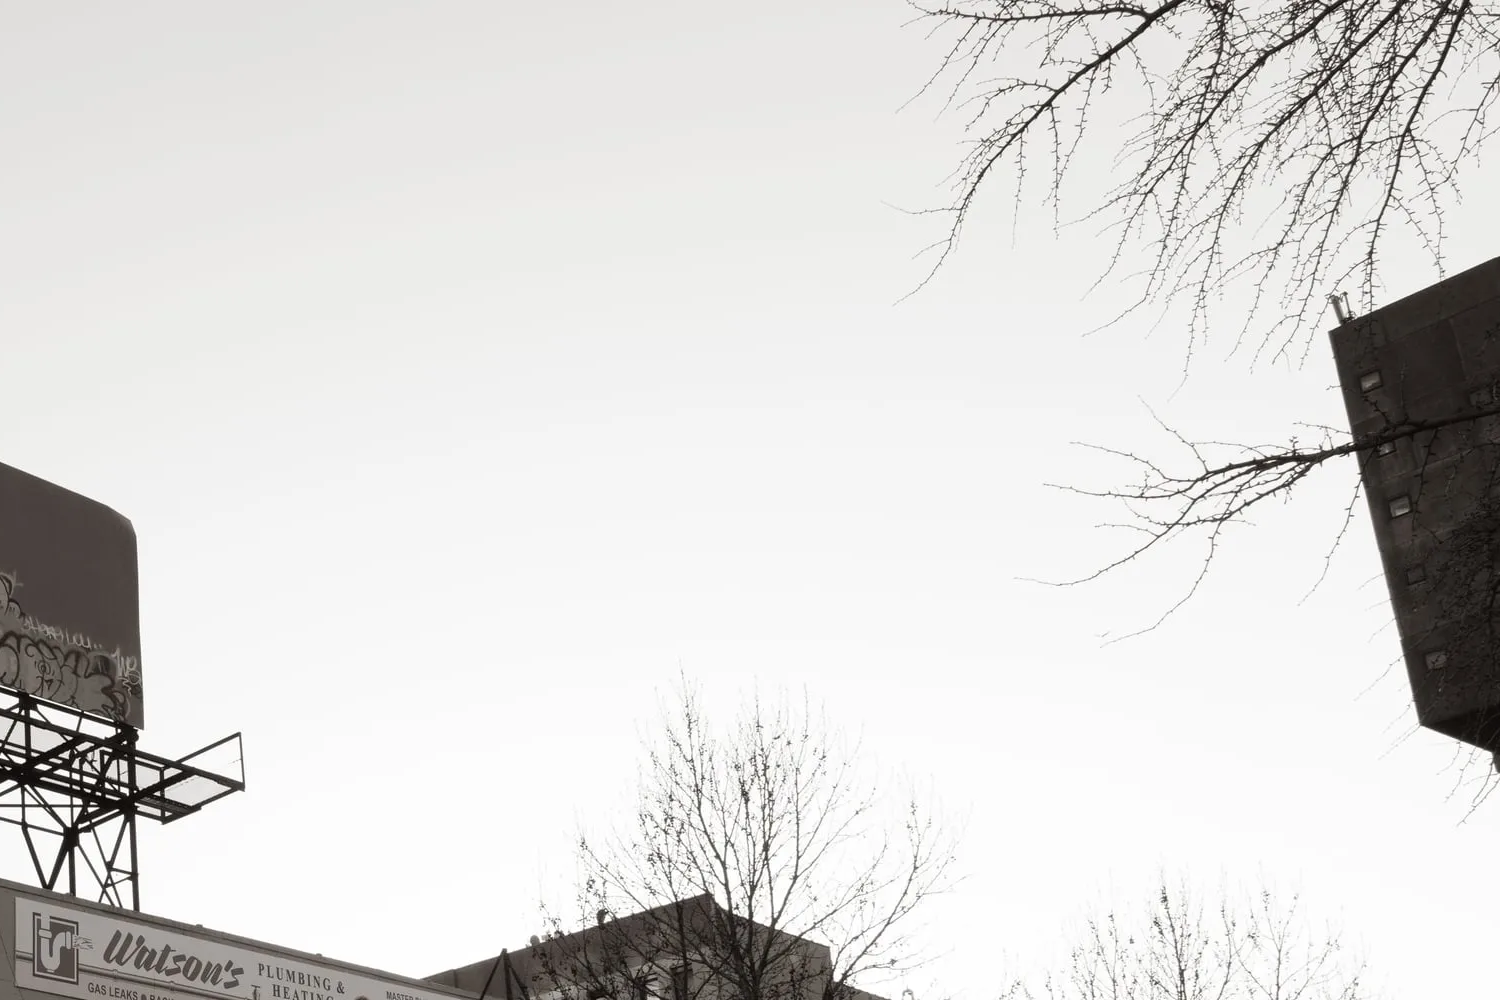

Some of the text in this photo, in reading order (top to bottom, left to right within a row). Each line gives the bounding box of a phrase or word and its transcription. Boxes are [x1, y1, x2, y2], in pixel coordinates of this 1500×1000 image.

[103, 929, 244, 989] Watson's
[88, 982, 107, 996] GAS
[258, 963, 345, 994] PLUMBING &
